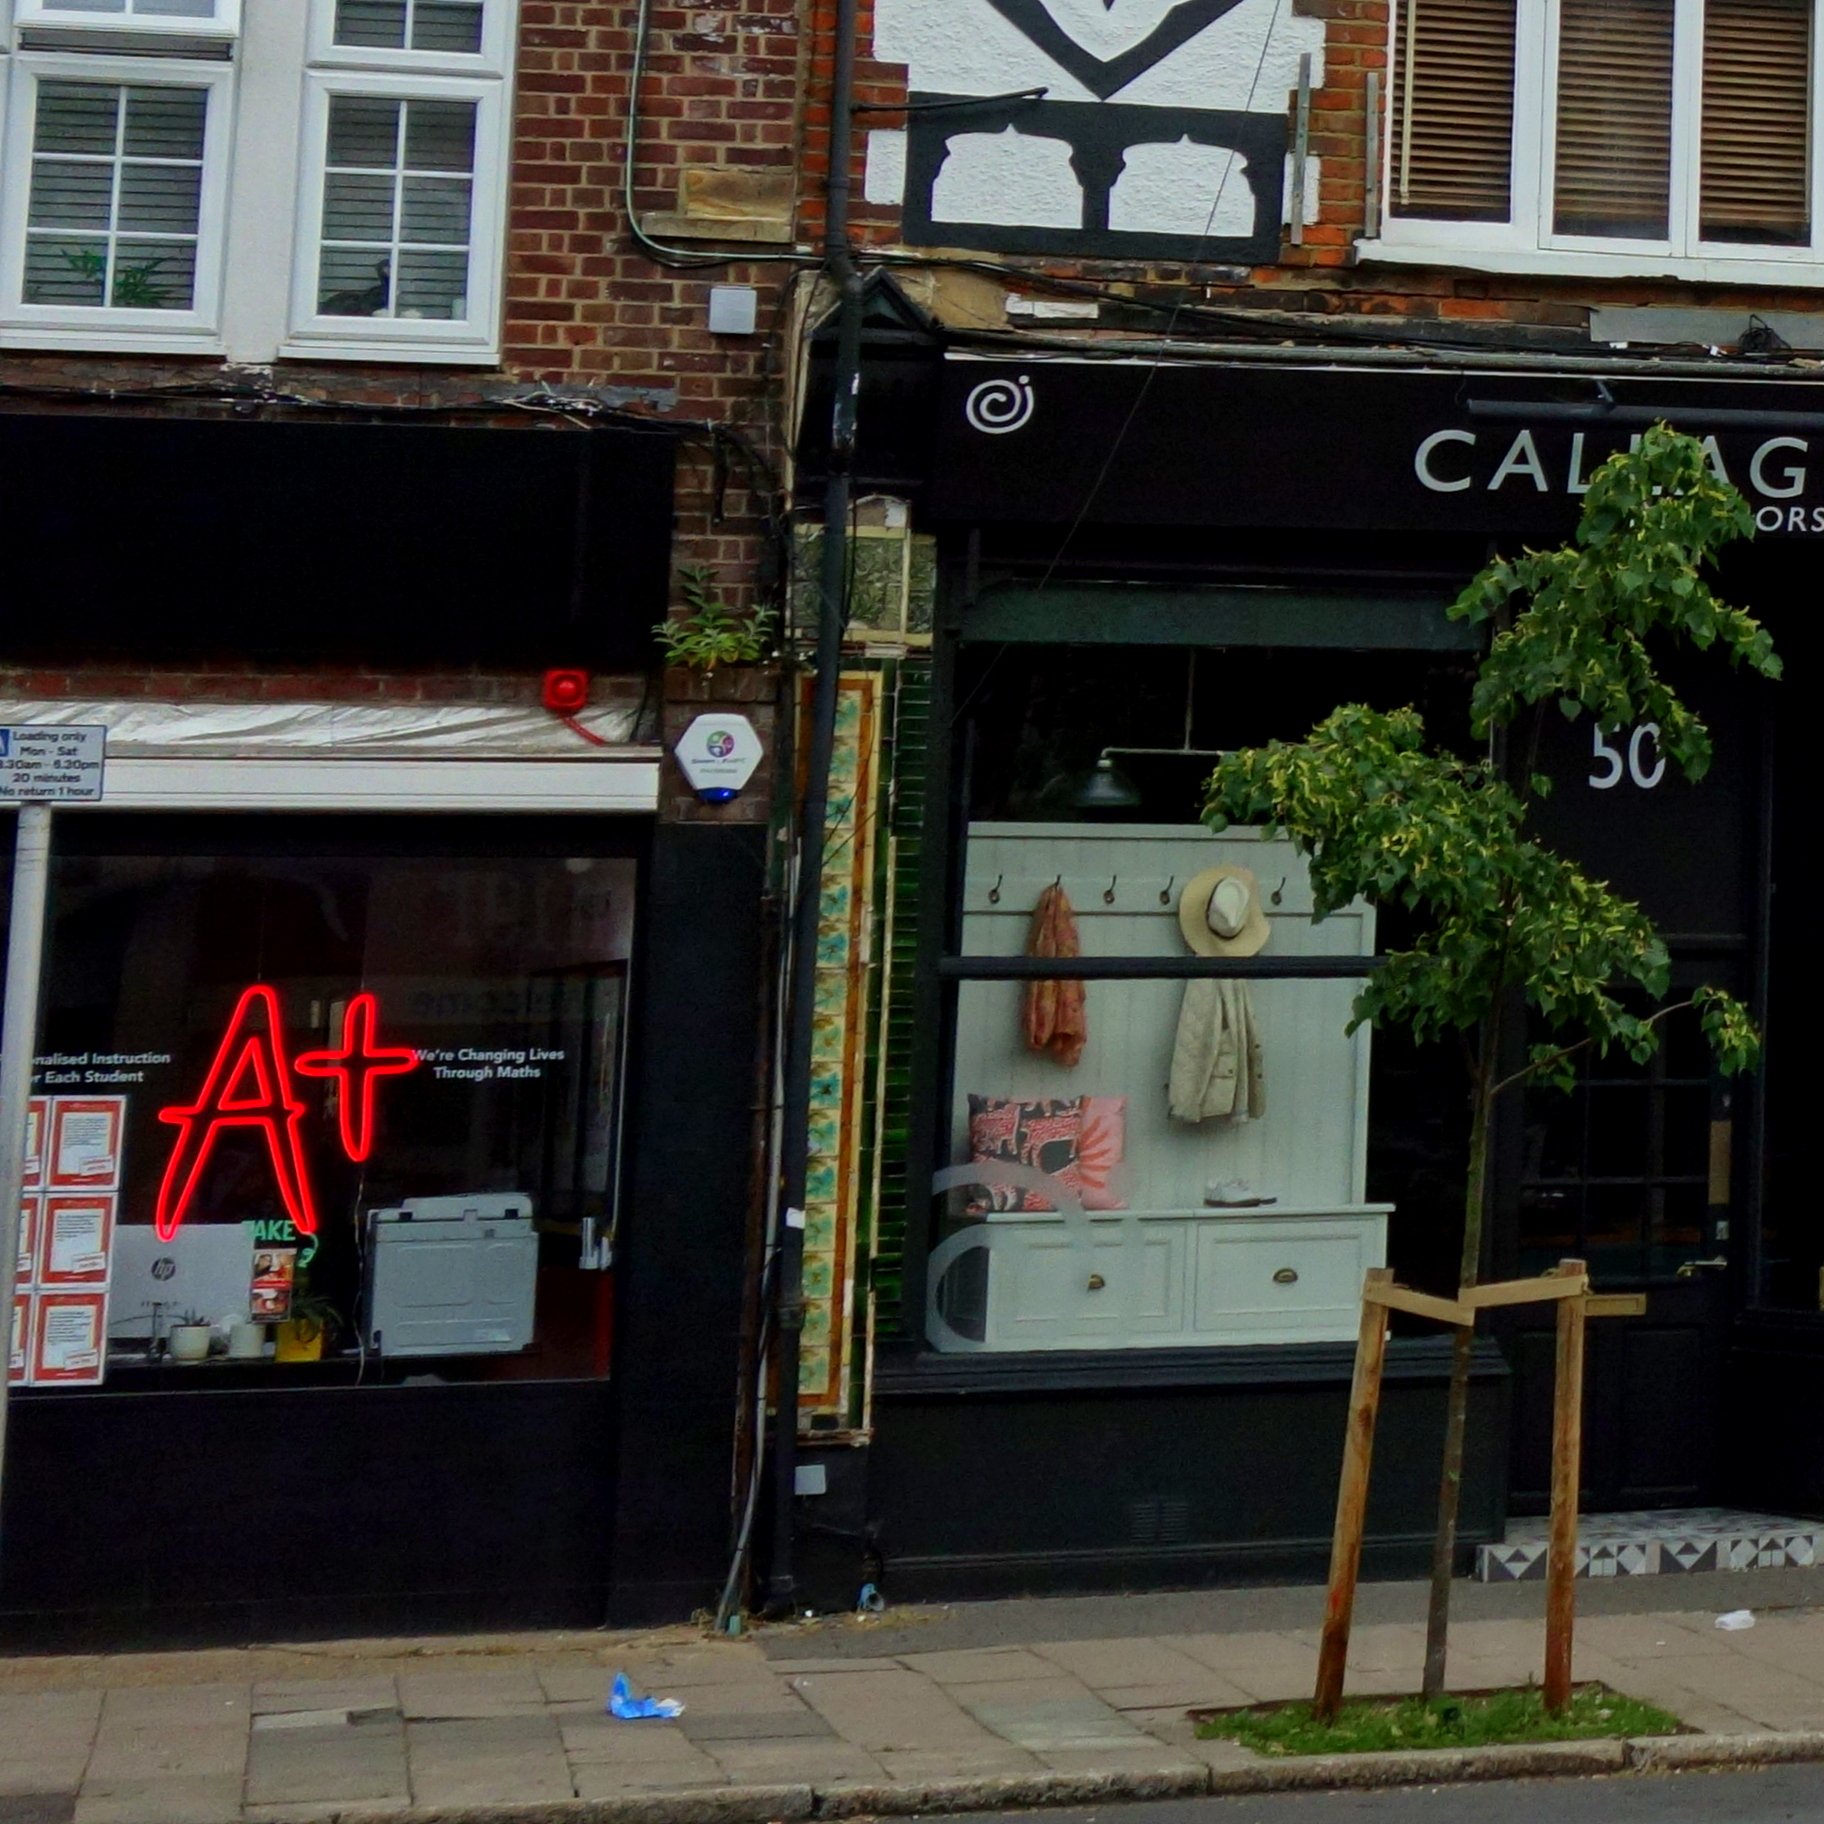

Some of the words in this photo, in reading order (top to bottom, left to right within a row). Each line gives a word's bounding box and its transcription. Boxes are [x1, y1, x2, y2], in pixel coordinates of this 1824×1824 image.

[13, 731, 59, 743] Loading
[61, 732, 88, 742] only
[20, 746, 46, 756] Mon
[57, 746, 77, 756] Sat
[1589, 722, 1667, 789] 50
[33, 772, 81, 782] minutes
[18, 787, 55, 796] return
[67, 787, 94, 796] hour
[92, 1051, 171, 1065] Instruction
[414, 1049, 455, 1061] We're
[458, 1048, 525, 1064] Changing
[529, 1048, 565, 1061] Lives
[45, 1071, 81, 1084] Each
[84, 1070, 144, 1083] Student
[433, 1066, 493, 1081] Through
[497, 1066, 541, 1078] Maths
[240, 1219, 297, 1241] TAKE
